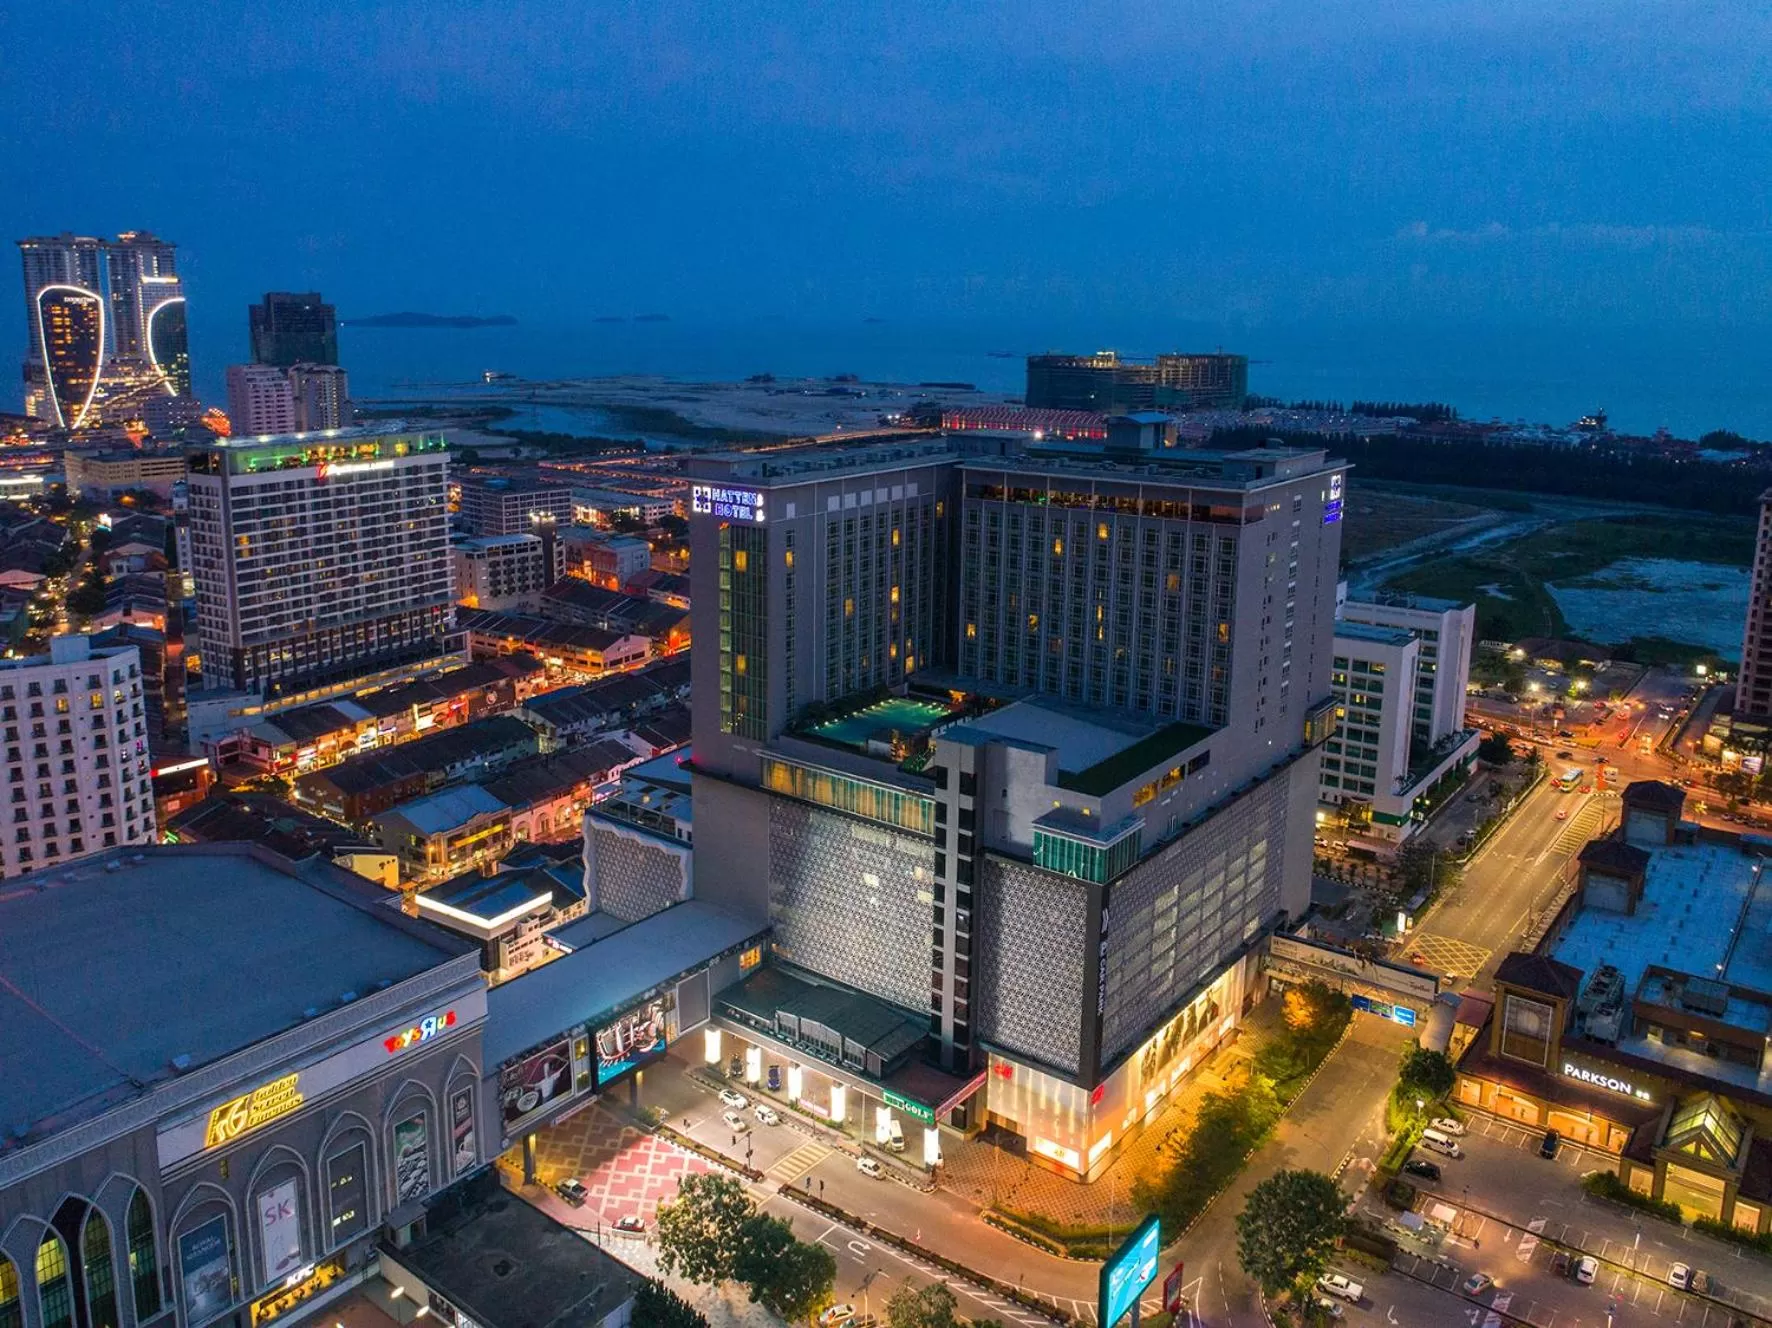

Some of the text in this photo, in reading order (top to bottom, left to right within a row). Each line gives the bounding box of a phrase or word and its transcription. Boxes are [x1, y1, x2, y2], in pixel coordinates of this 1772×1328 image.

[712, 487, 756, 506] HATTEN
[715, 503, 754, 520] HOTEL
[1564, 1063, 1632, 1095] PARKSON
[287, 1262, 316, 1288] KFC
